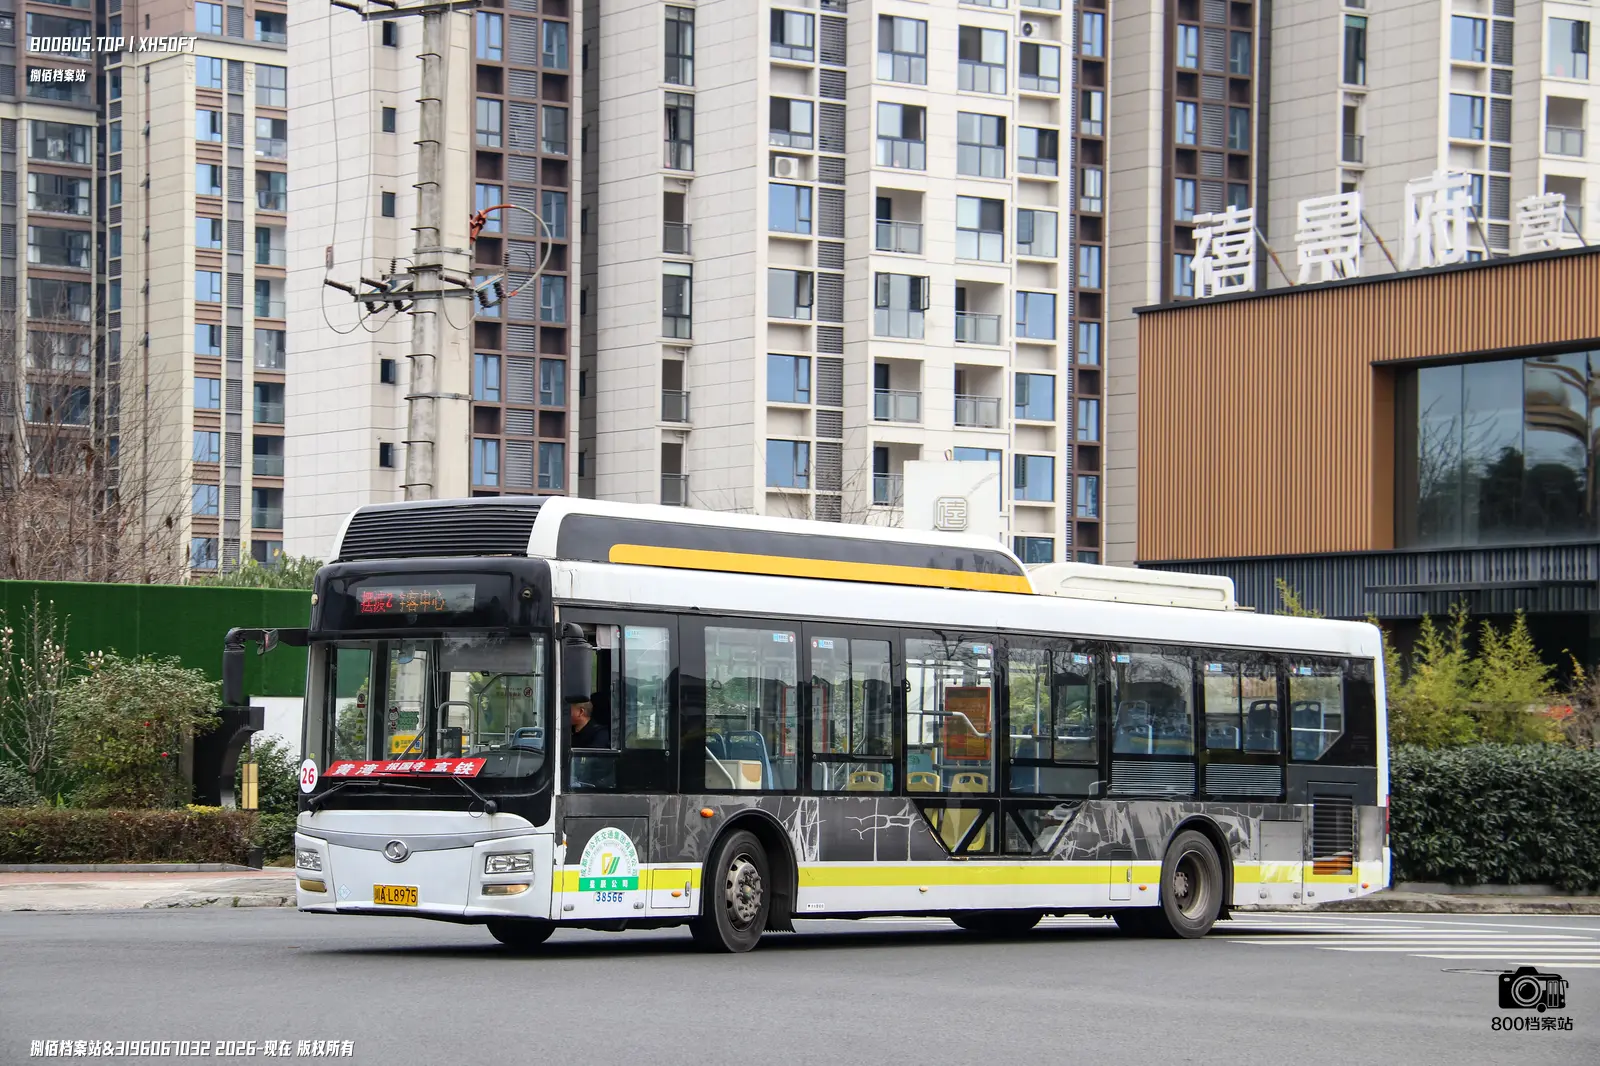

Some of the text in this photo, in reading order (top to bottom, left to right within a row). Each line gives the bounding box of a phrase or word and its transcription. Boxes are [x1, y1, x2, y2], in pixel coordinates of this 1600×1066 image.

[302, 767, 315, 785] 26
[332, 761, 476, 776] 黄湾 报国寺 高铁
[595, 891, 623, 903] 38566
